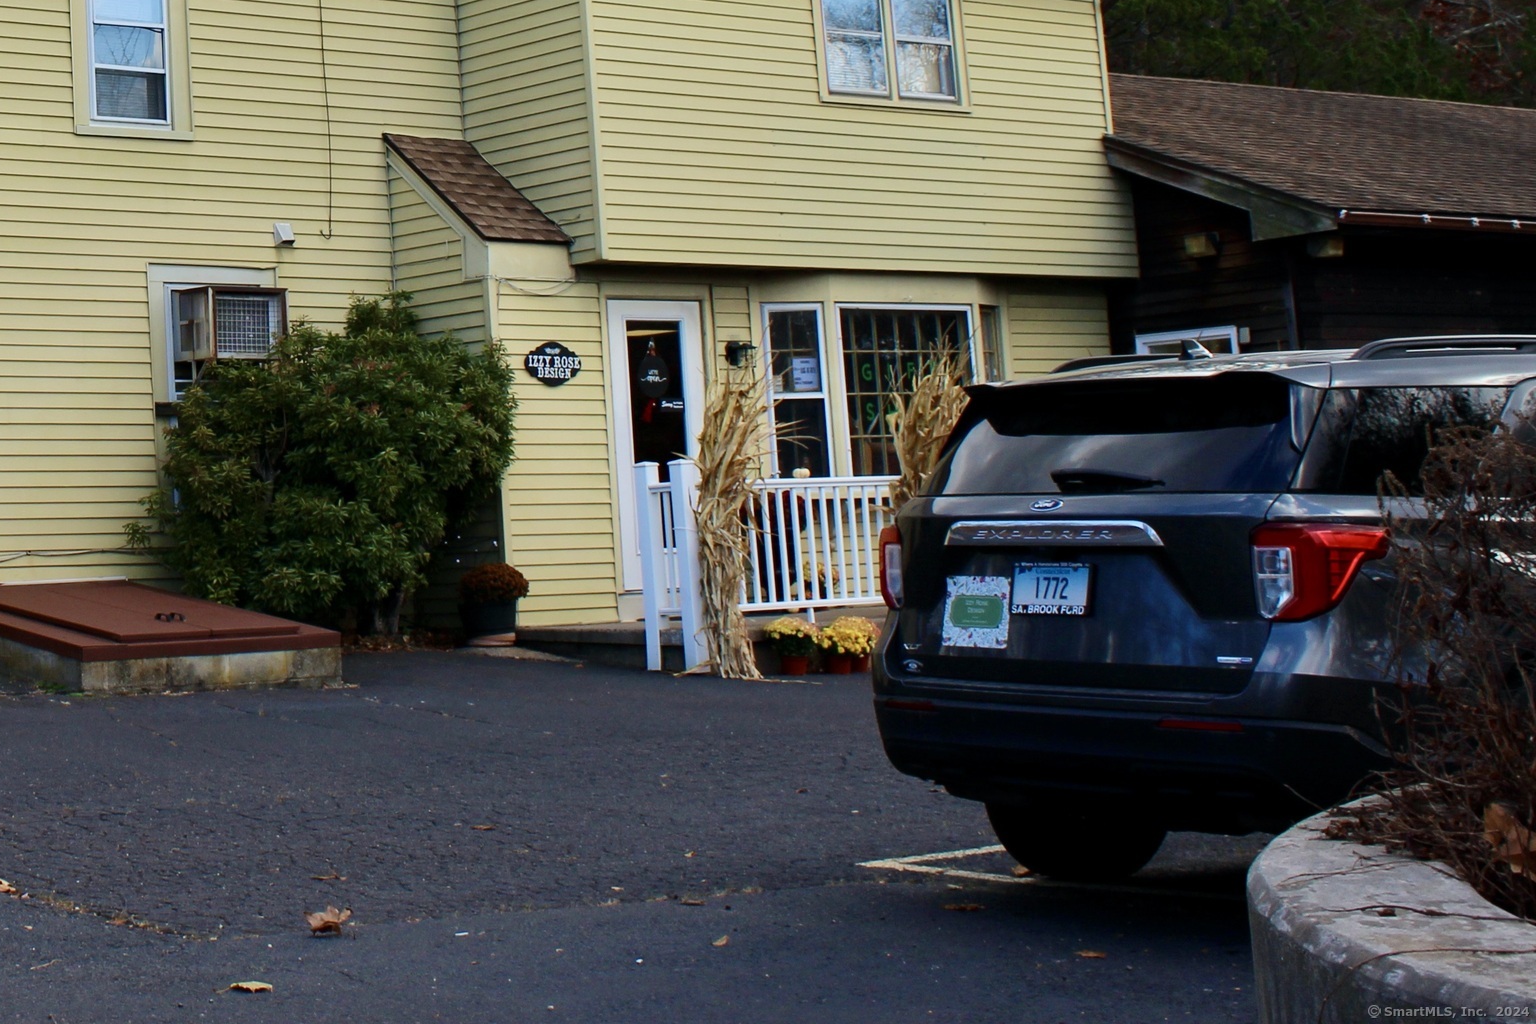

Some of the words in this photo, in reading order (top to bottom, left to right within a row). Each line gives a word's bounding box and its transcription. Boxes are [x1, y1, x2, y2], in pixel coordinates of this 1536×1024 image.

[528, 355, 552, 367] IZZY
[554, 356, 580, 369] ROSE
[537, 367, 571, 378] DESIGN
[972, 529, 1113, 540] EXPLORER
[1035, 576, 1069, 599] 1772
[1011, 604, 1026, 614] SA.
[1027, 605, 1058, 614] BROOK
